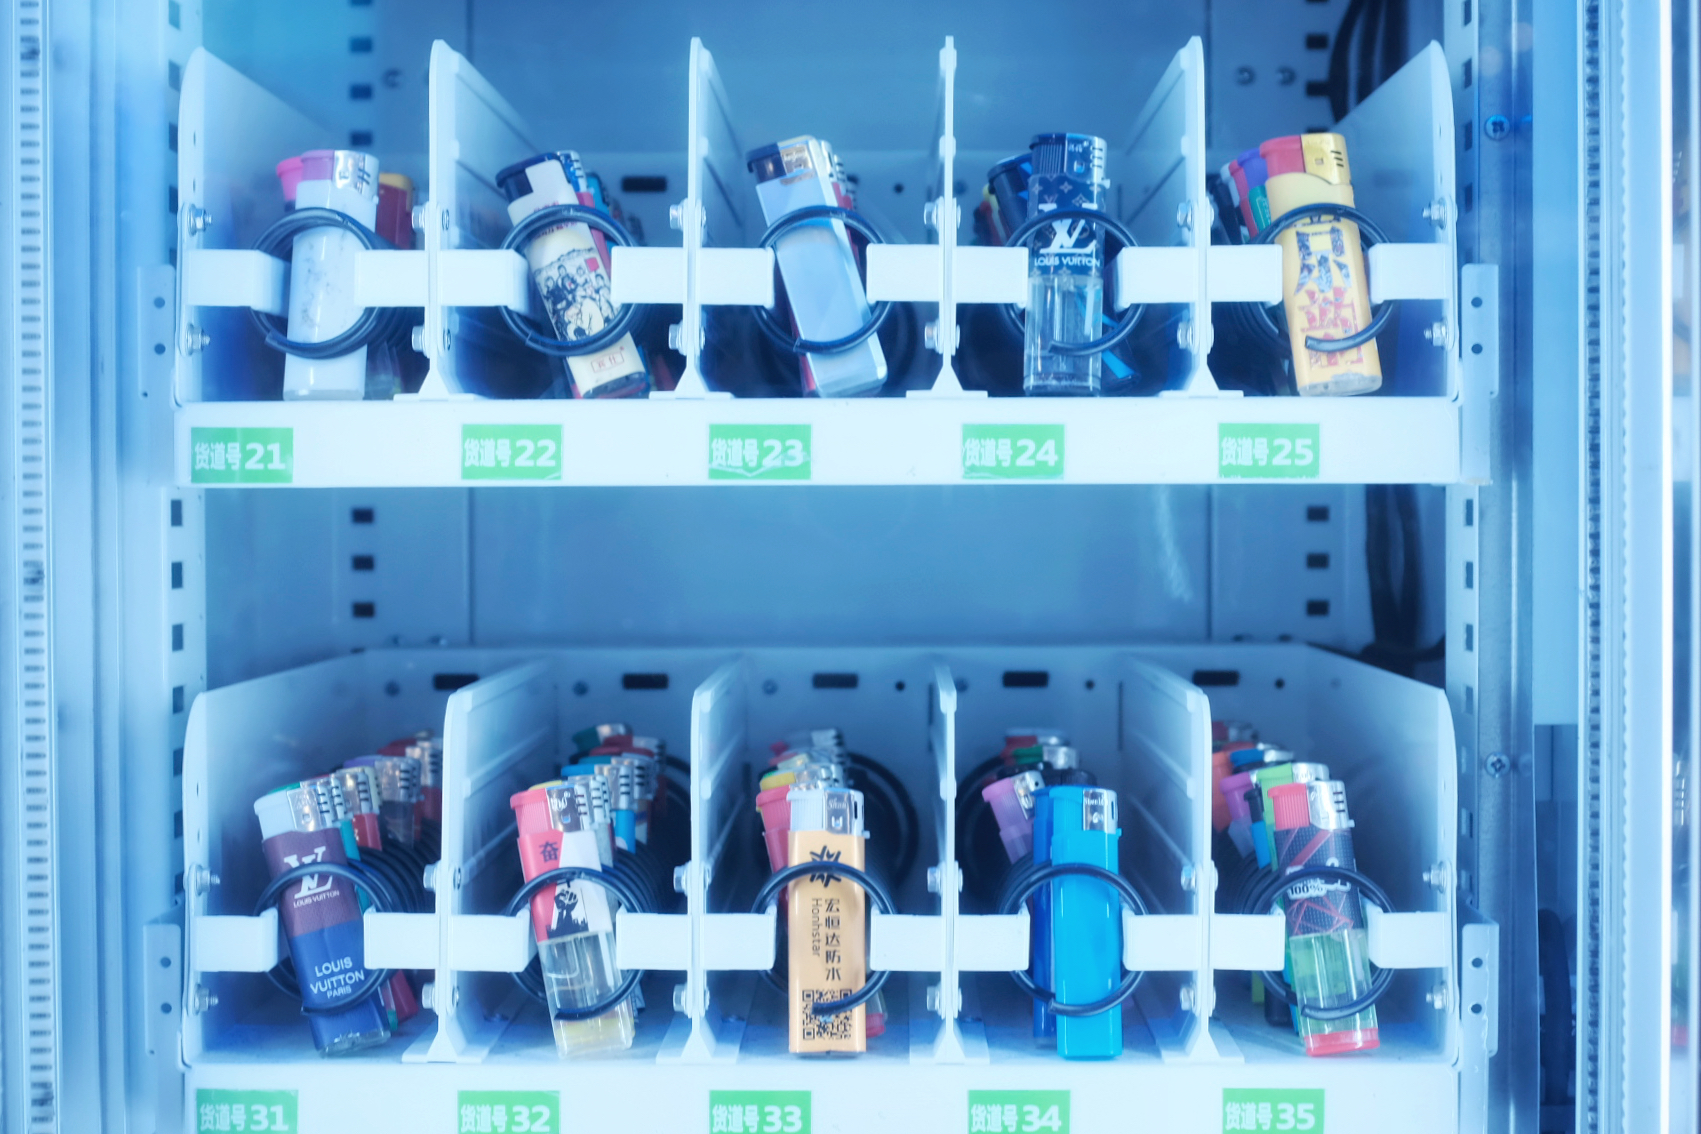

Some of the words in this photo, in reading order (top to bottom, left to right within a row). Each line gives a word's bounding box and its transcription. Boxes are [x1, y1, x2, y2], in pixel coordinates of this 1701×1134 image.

[1033, 256, 1059, 267] LOUIS
[1061, 256, 1100, 267] VUITTON
[194, 441, 287, 471] 货道号21
[463, 438, 557, 468] 货道号22
[711, 437, 804, 468] 货道号23
[964, 437, 1058, 467] 货道号24
[1221, 437, 1314, 466] 货道号25
[825, 897, 841, 981] 宏恒达防水
[310, 969, 365, 994] VUITTON
[315, 956, 353, 978] LOUIS
[327, 986, 352, 999] PARIS
[199, 1102, 289, 1132] 货道号31
[460, 1103, 551, 1133] 货道号32
[712, 1104, 803, 1133] 货道号33
[970, 1103, 1062, 1133] 货道号34
[1225, 1102, 1315, 1131] 货道号35
